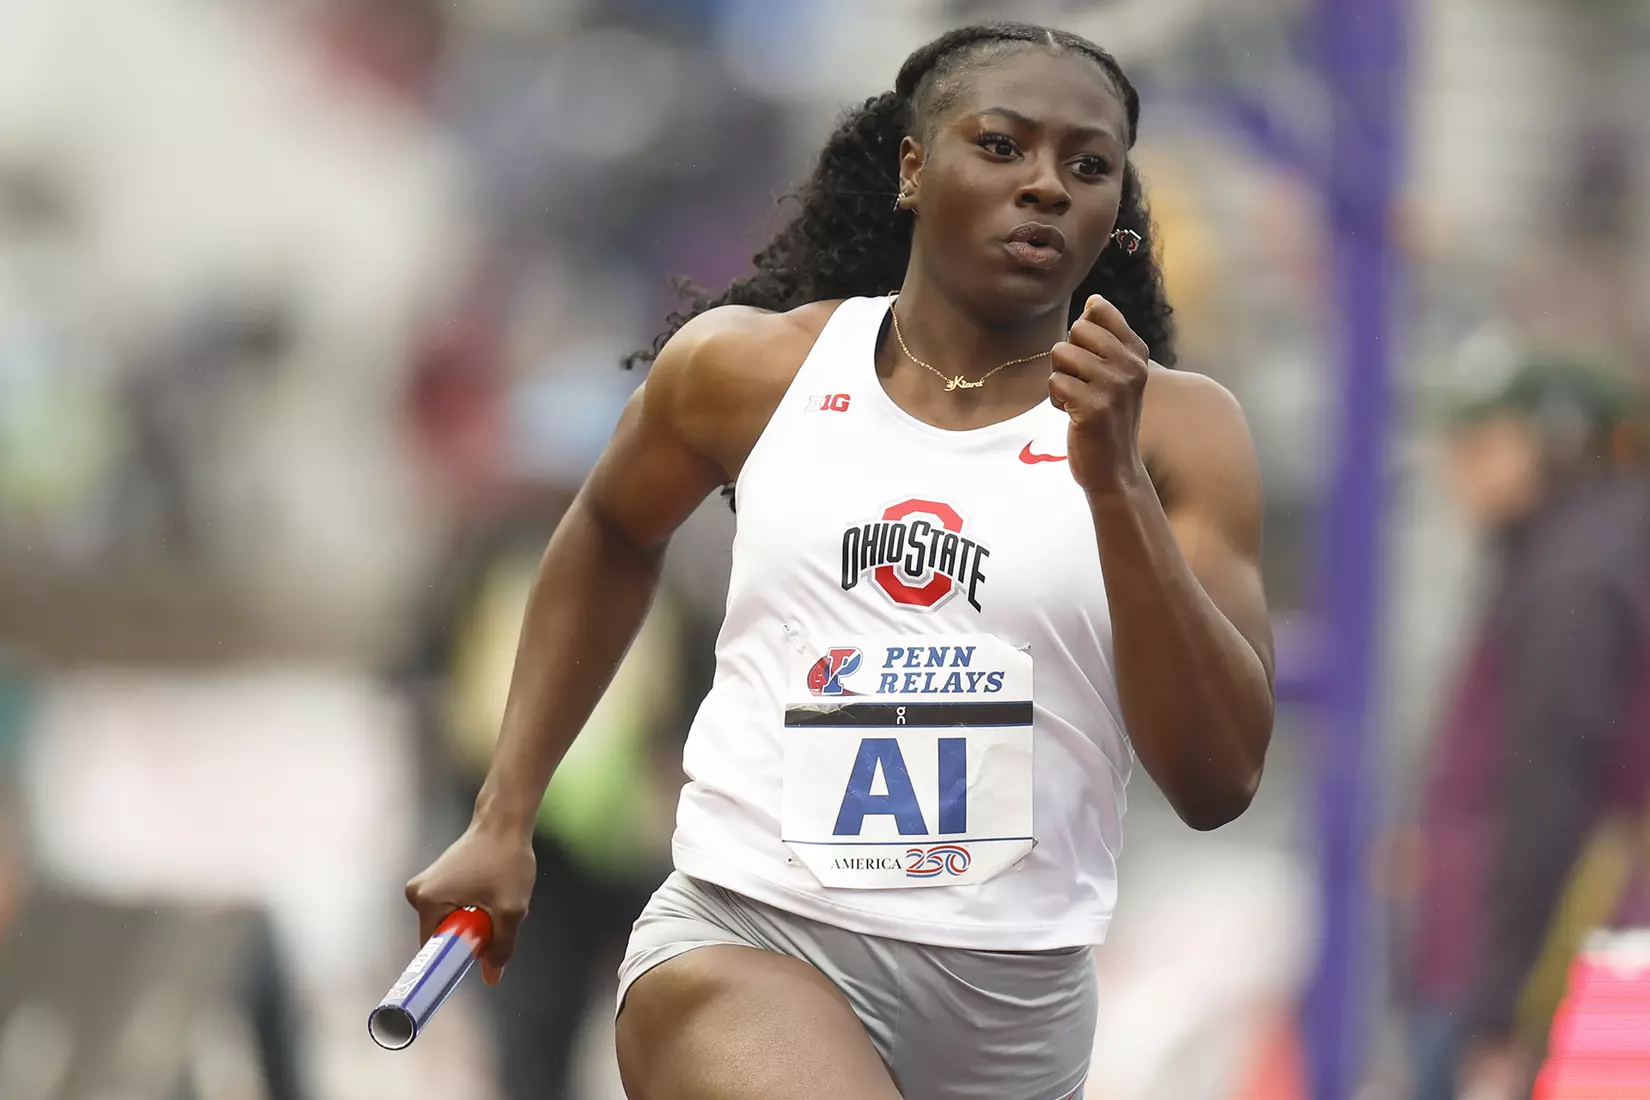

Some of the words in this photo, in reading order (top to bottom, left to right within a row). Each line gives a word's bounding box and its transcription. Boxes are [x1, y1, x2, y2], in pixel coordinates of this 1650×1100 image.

[841, 522, 907, 591] OHIO
[904, 520, 990, 613] STATE
[882, 646, 976, 668] PENN
[876, 671, 1005, 693] RELAYS
[832, 737, 967, 835] AI
[831, 857, 902, 870] AMERICA
[906, 845, 971, 878] 250
